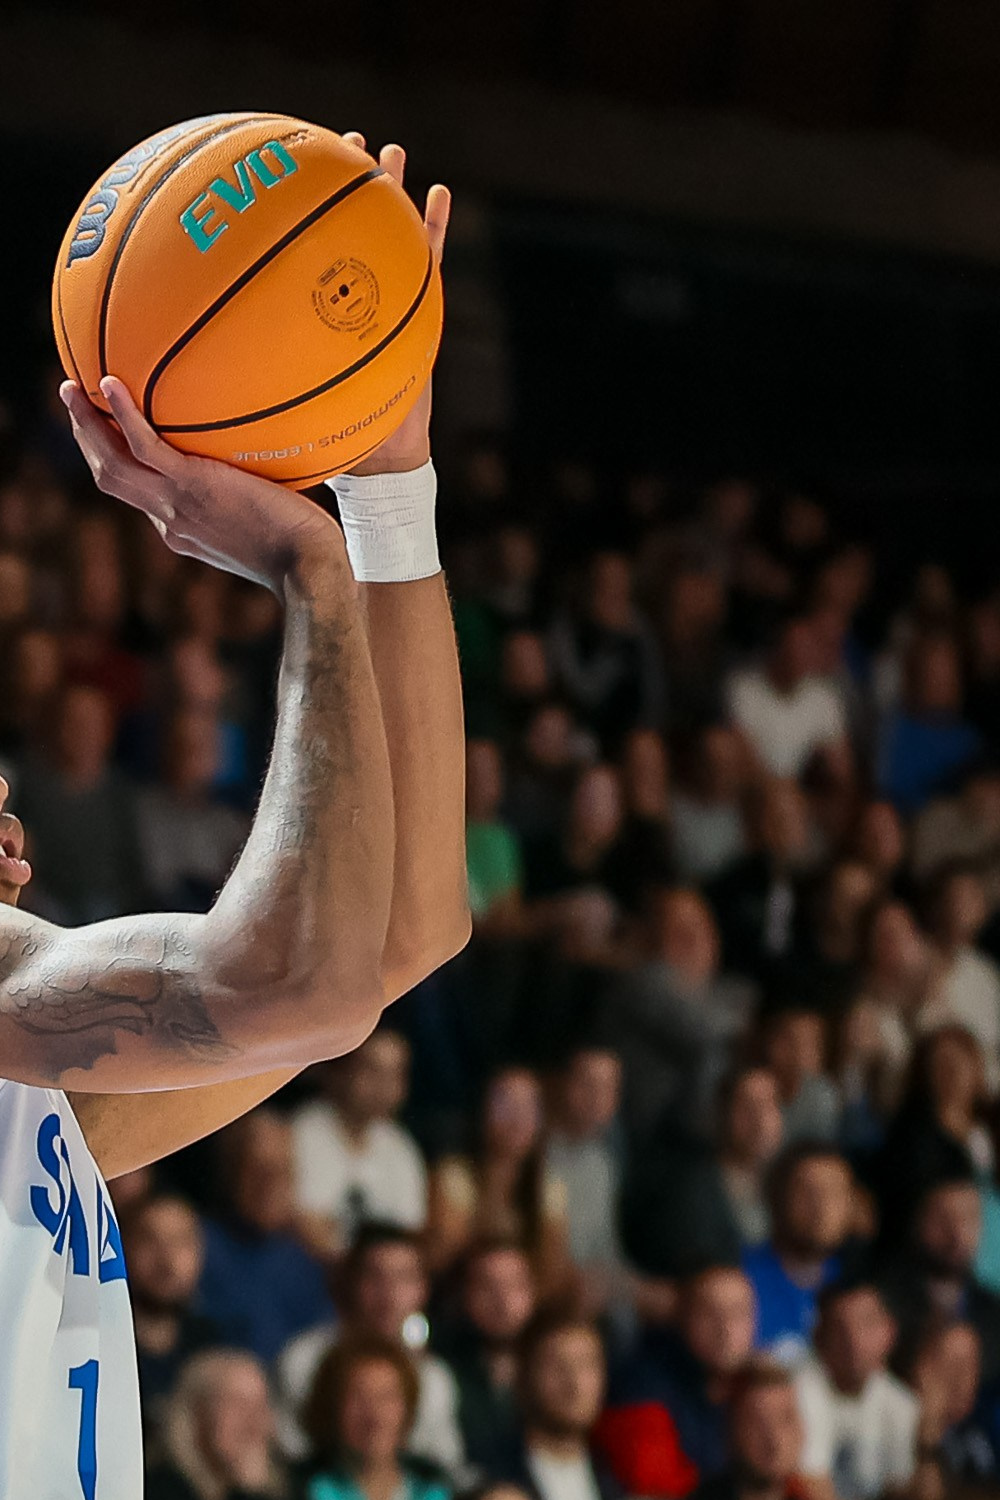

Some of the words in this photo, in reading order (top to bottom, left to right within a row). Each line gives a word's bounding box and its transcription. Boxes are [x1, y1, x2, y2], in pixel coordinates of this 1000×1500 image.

[179, 139, 298, 254] EVO
[318, 375, 416, 447] CHAMPIONS
[232, 441, 315, 462] LEAGUE
